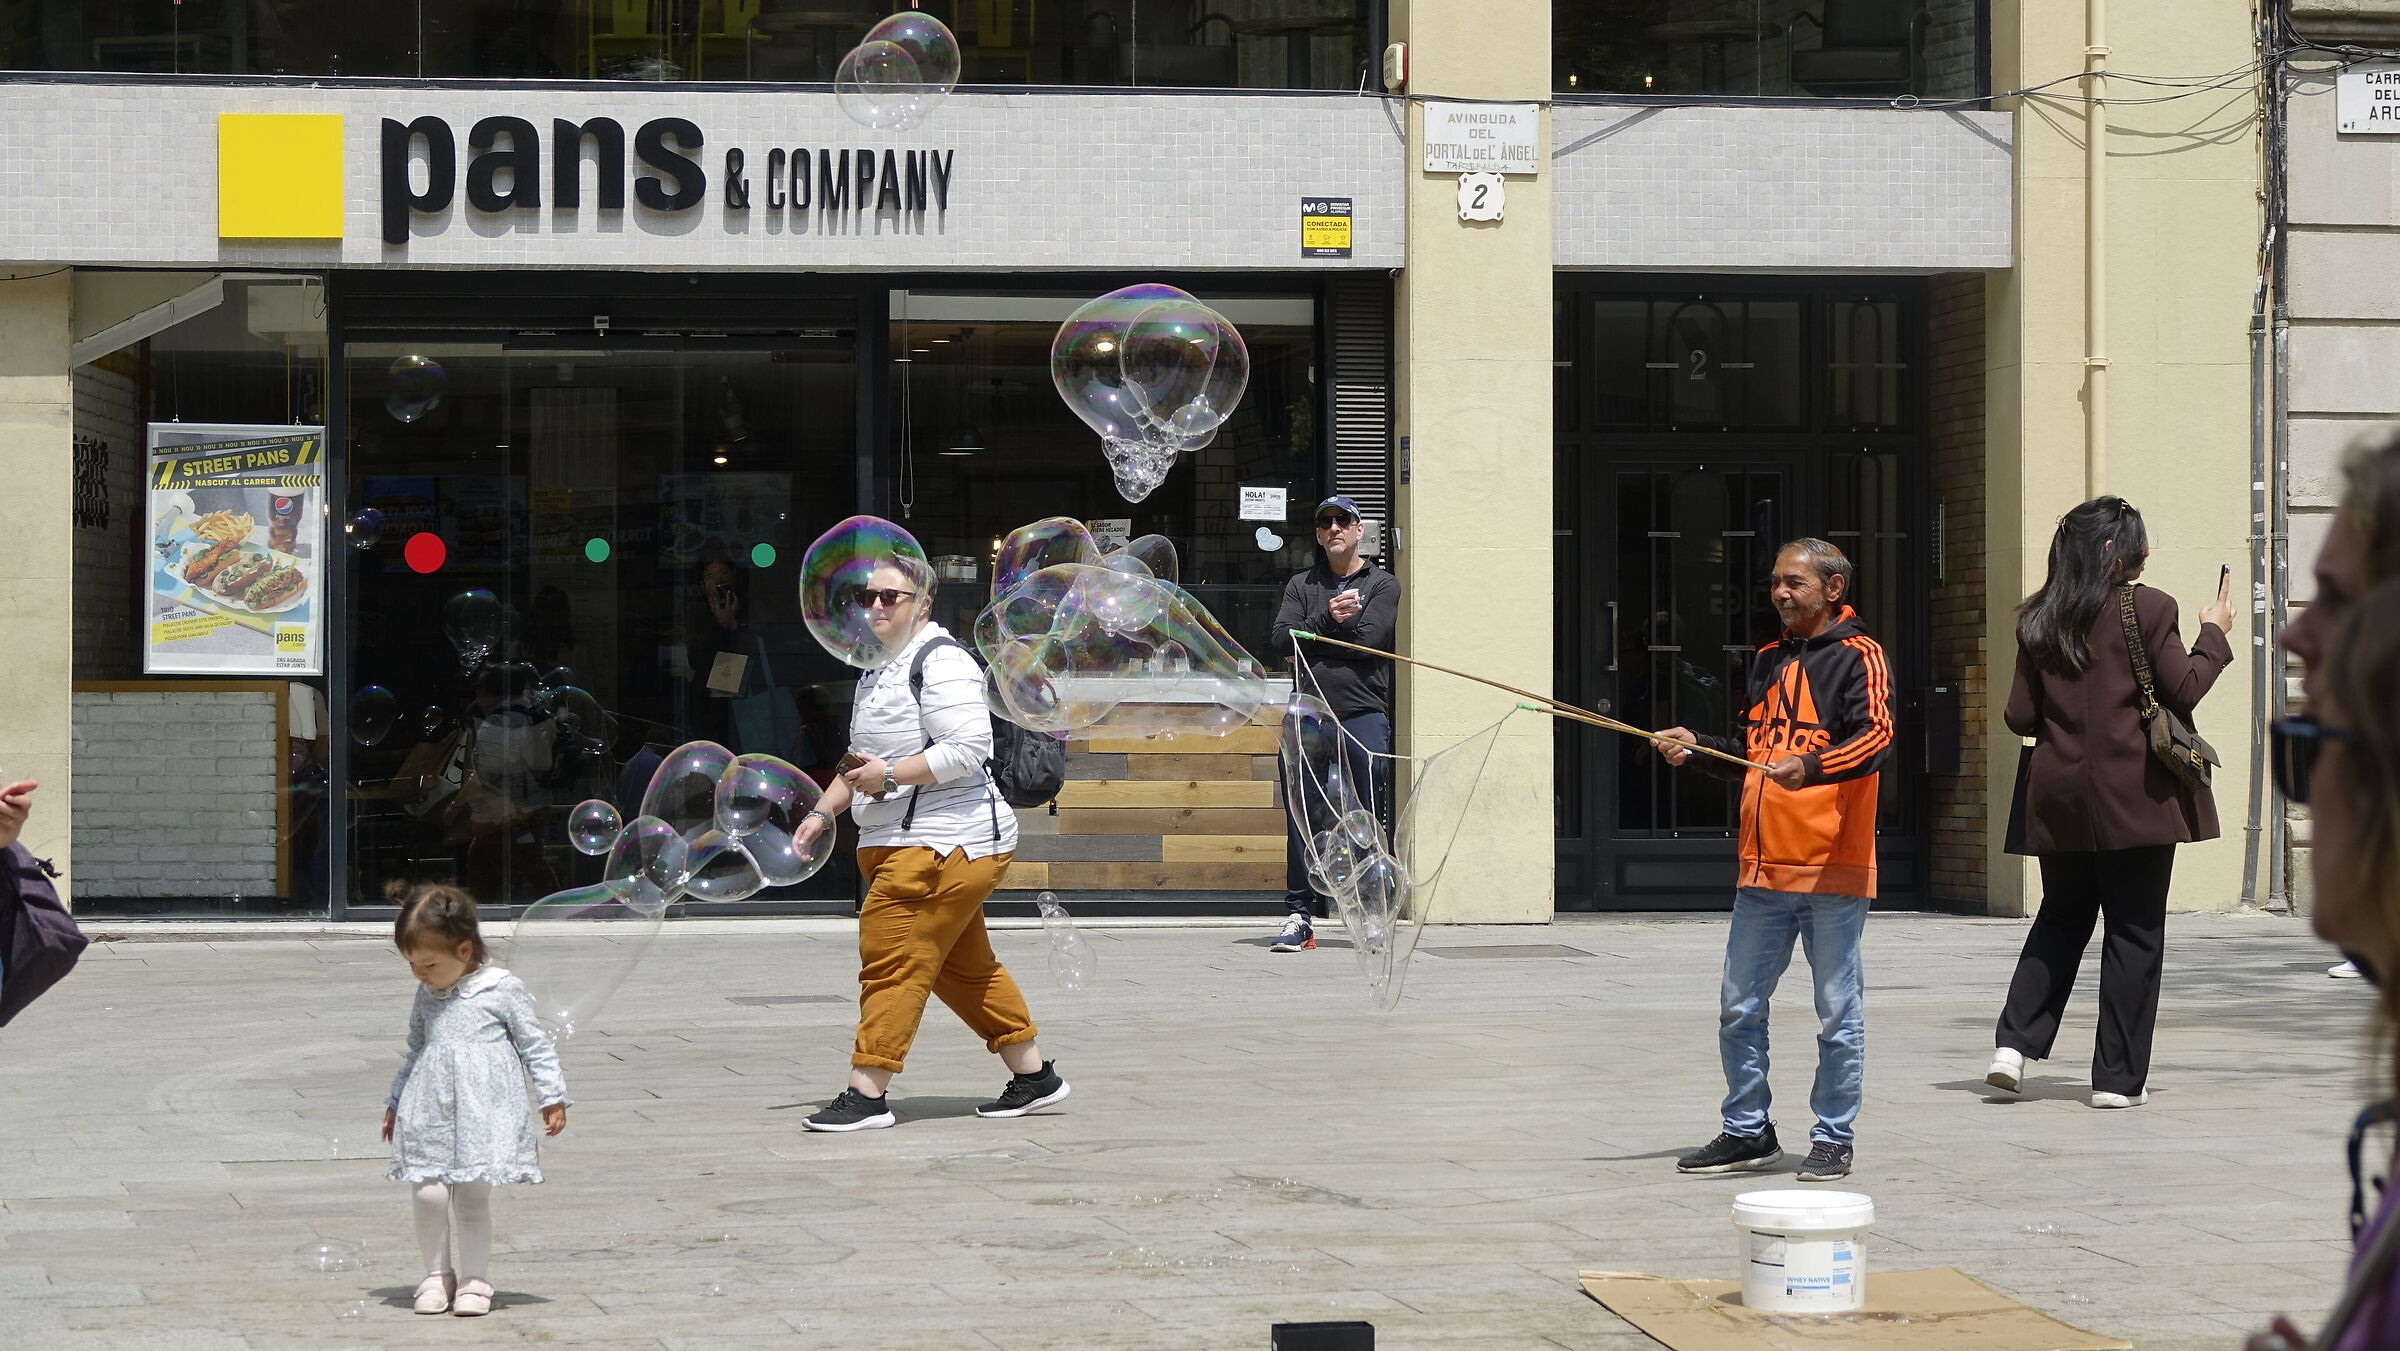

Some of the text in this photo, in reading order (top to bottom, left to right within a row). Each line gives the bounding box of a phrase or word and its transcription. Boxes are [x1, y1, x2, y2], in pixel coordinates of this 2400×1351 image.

[2375, 89, 2400, 100] DEL
[1447, 113, 1517, 125] AVINGUDA
[1469, 128, 1496, 139] DEL
[1425, 143, 1471, 160] PORTAL
[381, 115, 954, 245] pans & COMPANY
[1471, 183, 1488, 210] 2
[1690, 349, 1707, 380] 2
[182, 449, 290, 477] STREET PANS
[195, 479, 229, 487] NASCUT
[244, 478, 276, 486] CARRER
[162, 610, 197, 620] STREET PANS
[276, 632, 305, 644] pans
